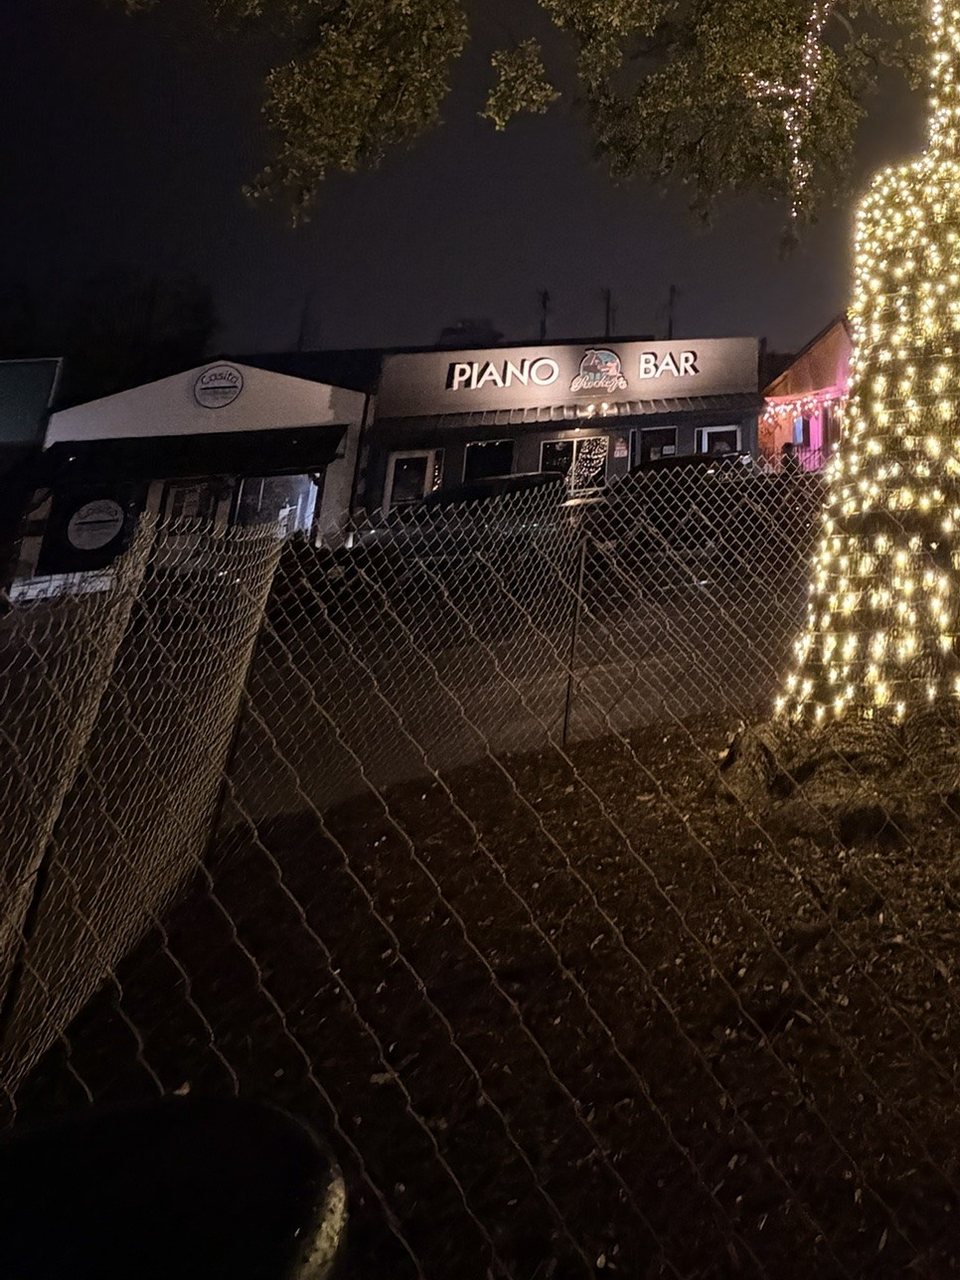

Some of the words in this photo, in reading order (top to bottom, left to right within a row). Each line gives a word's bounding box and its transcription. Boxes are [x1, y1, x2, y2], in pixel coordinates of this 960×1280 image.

[201, 370, 239, 385] Casita
[451, 358, 560, 391] PIANO
[639, 351, 698, 379] BAR
